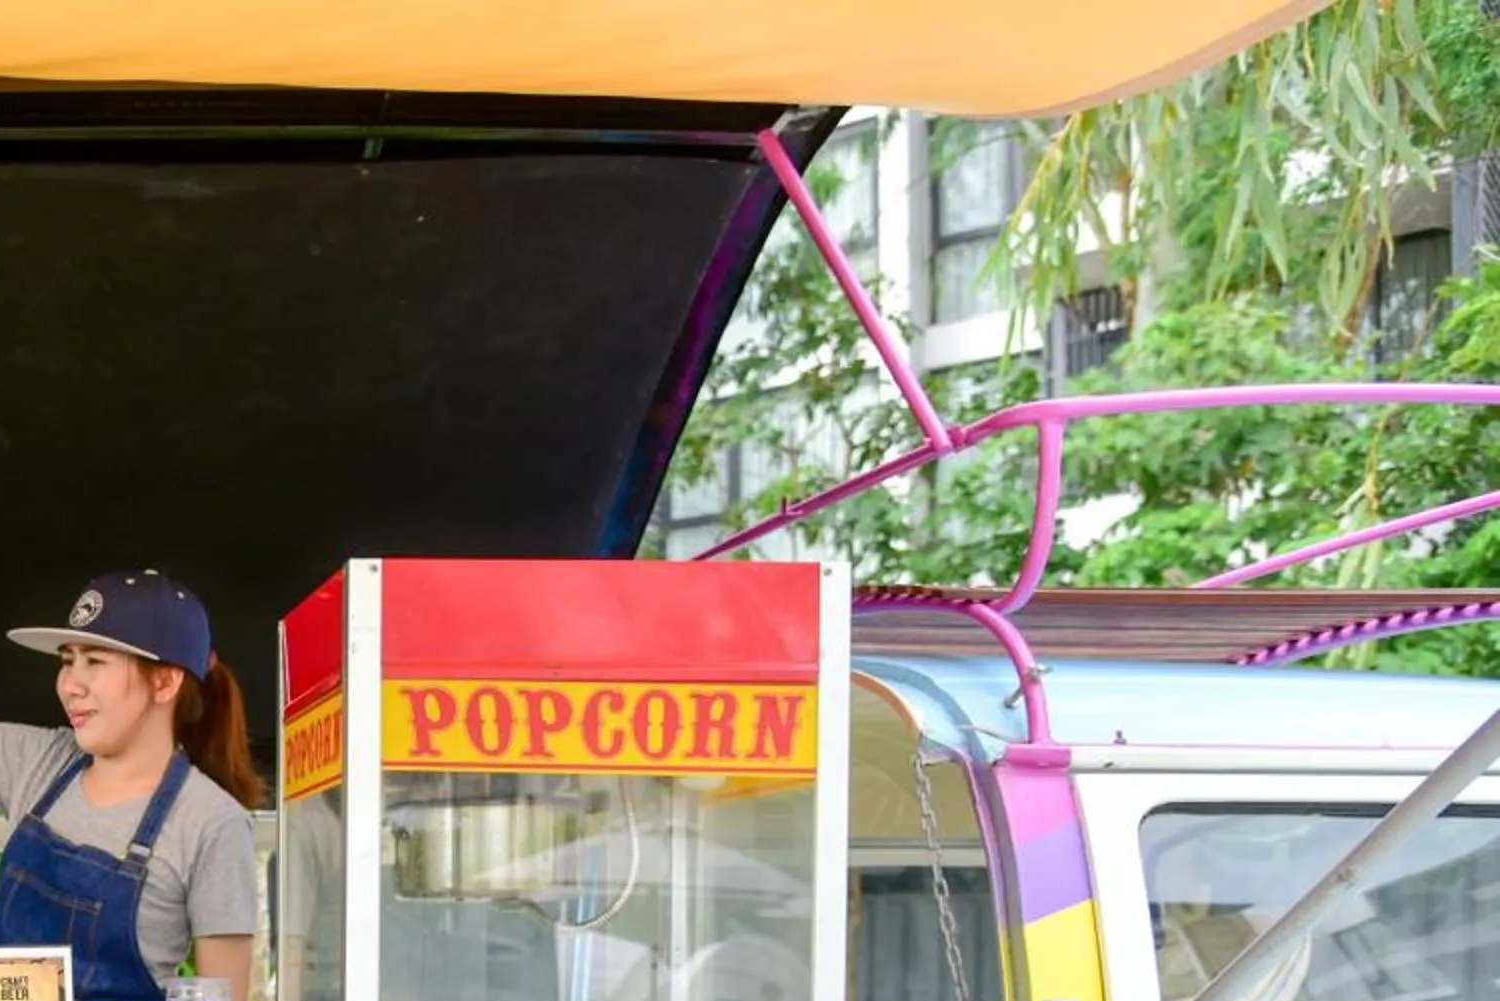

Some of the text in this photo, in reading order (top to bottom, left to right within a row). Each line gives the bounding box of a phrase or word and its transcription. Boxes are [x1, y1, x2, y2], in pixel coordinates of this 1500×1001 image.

[401, 686, 803, 760] POPCORN
[286, 713, 342, 786] POPCORN
[0, 976, 29, 987] CRAFT
[1, 988, 29, 1000] BEER
